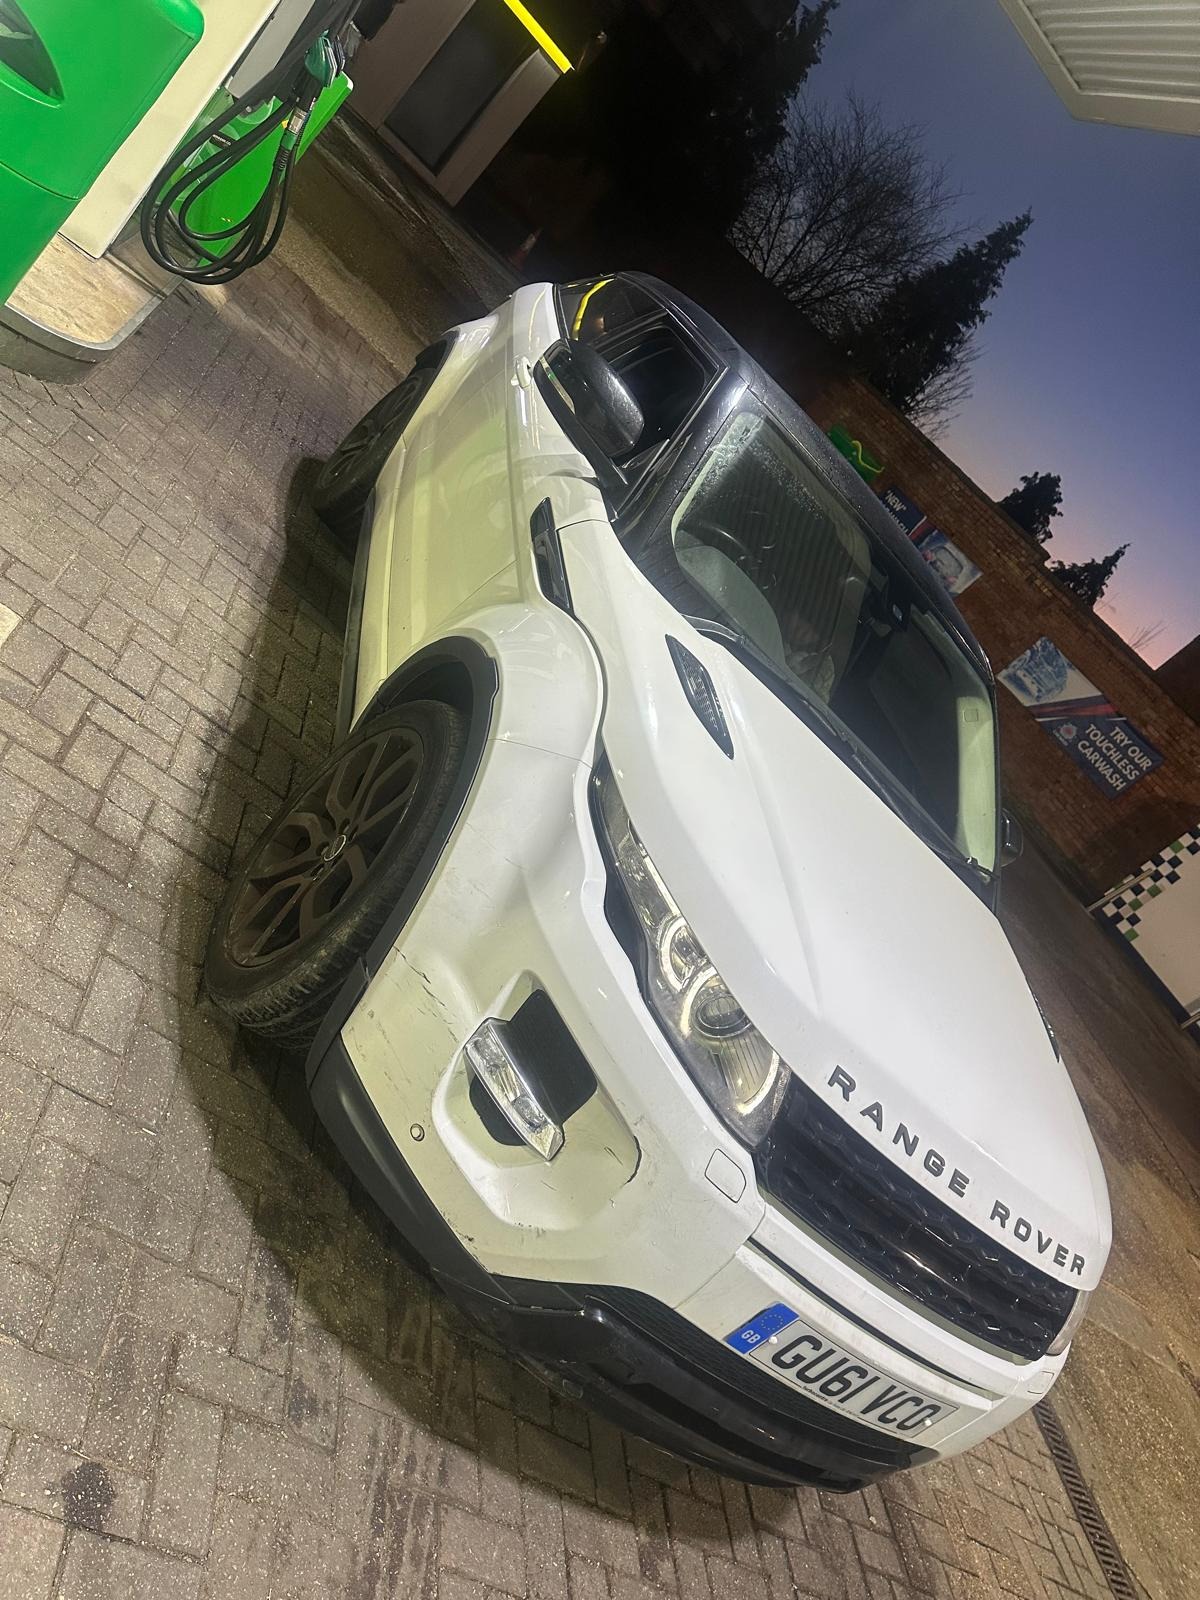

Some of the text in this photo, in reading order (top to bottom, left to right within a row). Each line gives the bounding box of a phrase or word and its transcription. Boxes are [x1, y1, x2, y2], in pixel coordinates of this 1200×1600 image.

[1077, 740, 1127, 791] CARWASH
[1084, 723, 1140, 781] TOUCHLESS
[1109, 726, 1152, 771] TRY OUR
[827, 1064, 1086, 1276] RANGE ROVER
[741, 1328, 761, 1344] GB
[771, 1334, 881, 1403] GU61
